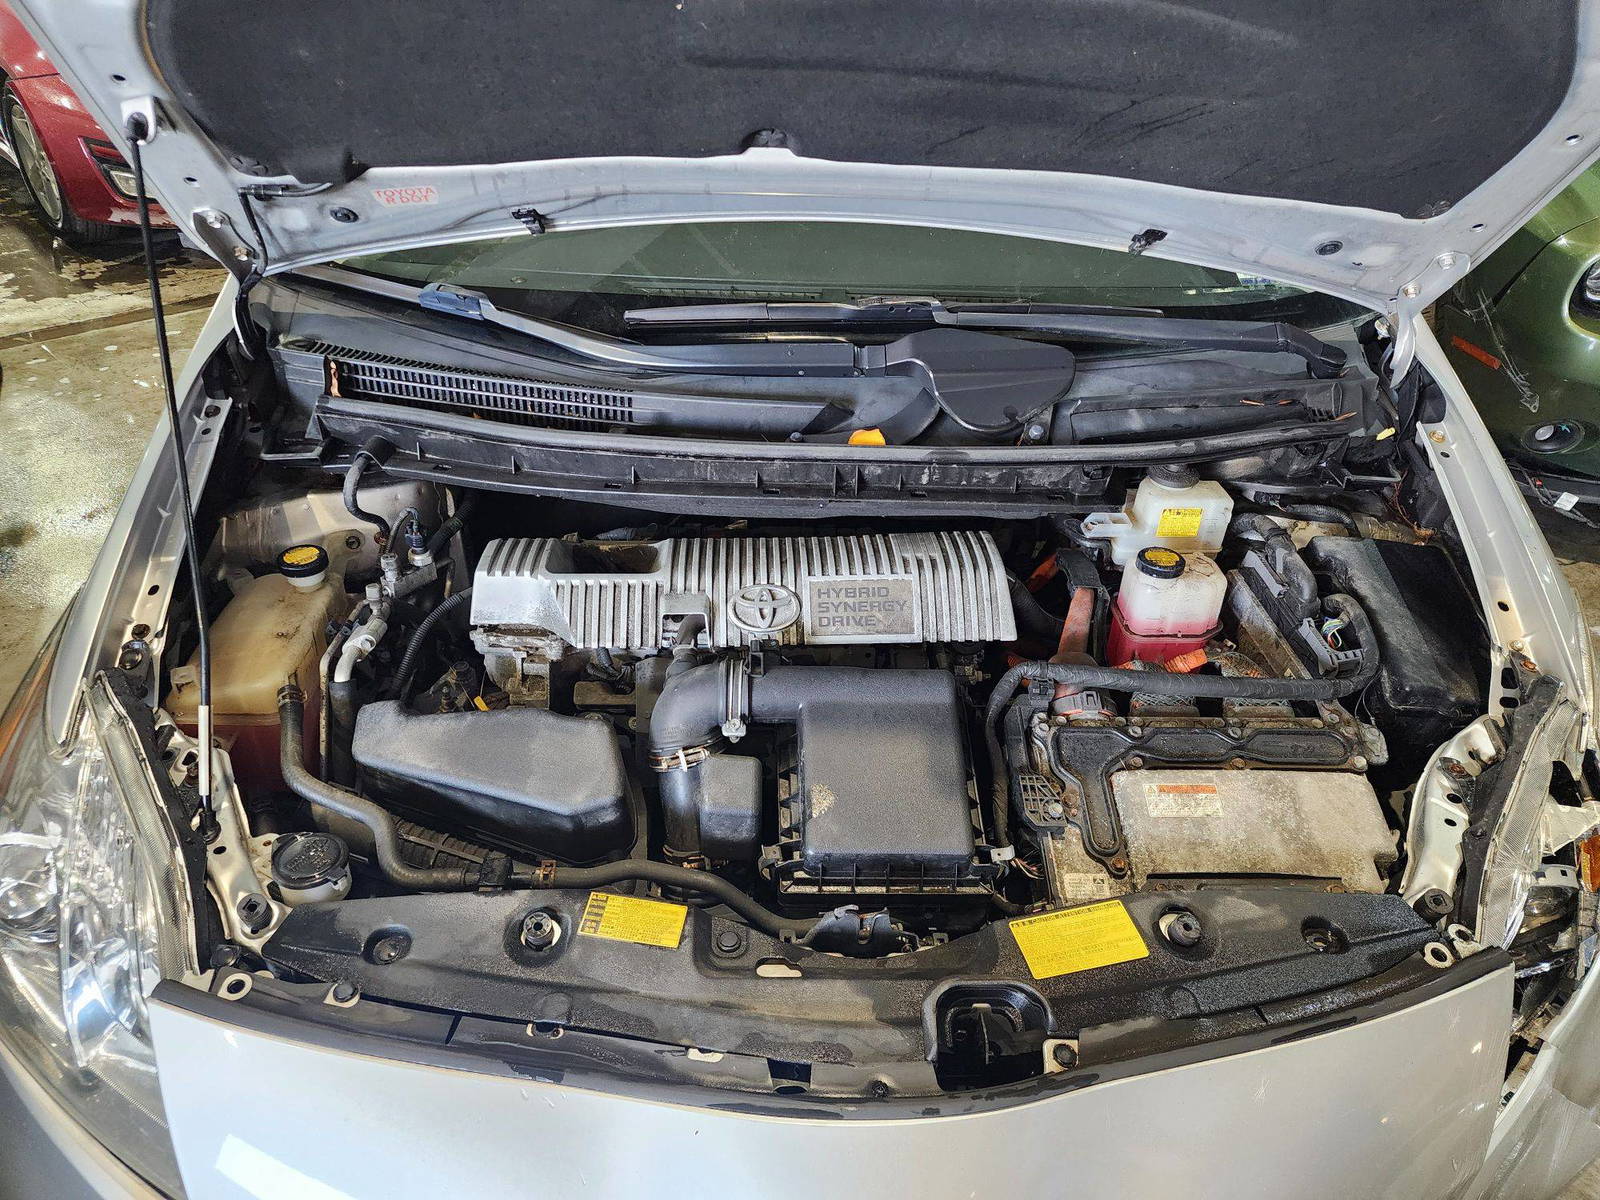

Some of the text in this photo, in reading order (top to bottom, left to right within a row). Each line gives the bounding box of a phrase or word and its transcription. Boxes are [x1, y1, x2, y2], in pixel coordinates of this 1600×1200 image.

[375, 187, 435, 199] TOYOTA
[817, 586, 890, 599] HYBRID
[817, 600, 908, 613] SYNERGY
[818, 615, 877, 628] DRIVE
